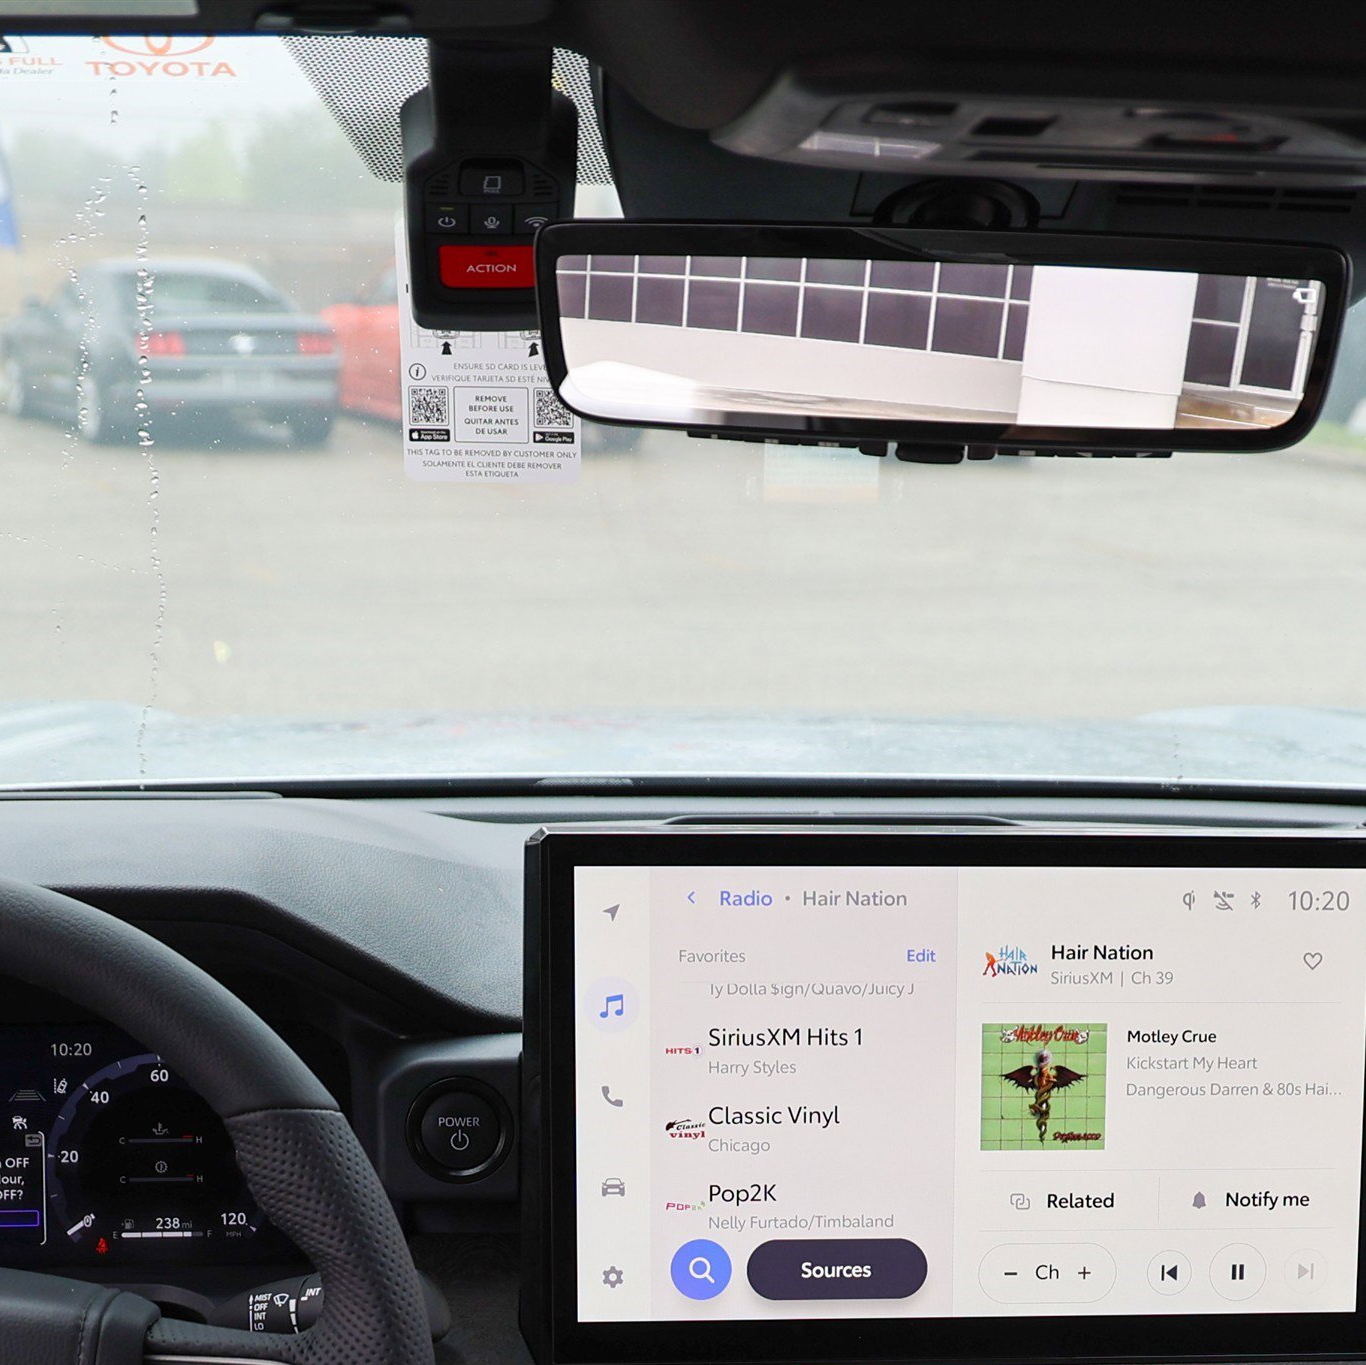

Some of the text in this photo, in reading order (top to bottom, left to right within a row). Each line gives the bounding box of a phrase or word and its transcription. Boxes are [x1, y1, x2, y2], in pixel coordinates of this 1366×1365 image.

[7, 56, 63, 67] FULL
[85, 60, 237, 78] TOYOTA
[13, 67, 54, 77] Dealer
[466, 264, 517, 273] ACTION
[453, 363, 484, 371] ENSURE
[485, 363, 496, 371] SD
[498, 363, 519, 371] CARD
[431, 375, 472, 383] VERIFIQUE
[473, 375, 504, 383] TARJETA
[517, 374, 536, 383] ESTÉ
[464, 418, 519, 426] QUITAR ANTES
[464, 449, 501, 457] REMOVED
[514, 450, 555, 458] CUSTOMER
[422, 460, 466, 468] SOLAMENTE
[507, 461, 526, 469] DEBE
[527, 462, 561, 470] REMOVER
[484, 470, 519, 478] ETIQUETA
[719, 890, 908, 907] Radio Hair Nation
[1288, 890, 1351, 912] 10:20
[678, 948, 936, 964] Favorites Edit
[997, 944, 1038, 977] HAIR NATION
[1051, 944, 1154, 961] Hair Nation
[1050, 970, 1174, 987] SiriusXM Ch 39
[707, 1027, 863, 1047] SiriusXM Hits 1
[1126, 1028, 1217, 1046] Motley Crue
[50, 1042, 93, 1057] 10:20
[665, 1047, 693, 1056] HITS
[708, 1060, 797, 1078] Harry Styles
[1126, 1055, 1258, 1074] Kickstart My Heart
[1125, 1082, 1207, 1101] Dangerous
[1209, 1082, 1260, 1098] Darren
[1262, 1082, 1275, 1098] &
[1276, 1082, 1302, 1098] 80s
[438, 1116, 480, 1127] POWER
[708, 1105, 840, 1130] Classic Vinyl
[669, 1129, 706, 1142] vinyl
[708, 1137, 771, 1156] Chicago
[4, 1157, 30, 1169] OFF
[708, 1183, 778, 1208] Pop2K
[1046, 1192, 1311, 1212] Related Notify me
[708, 1213, 895, 1232] Nelly Furtado/Timbaland
[800, 1260, 872, 1280] Sources
[1035, 1264, 1060, 1281] Ch
[254, 1293, 272, 1302] MIST
[254, 1303, 268, 1312] OFF
[254, 1312, 267, 1321] INT
